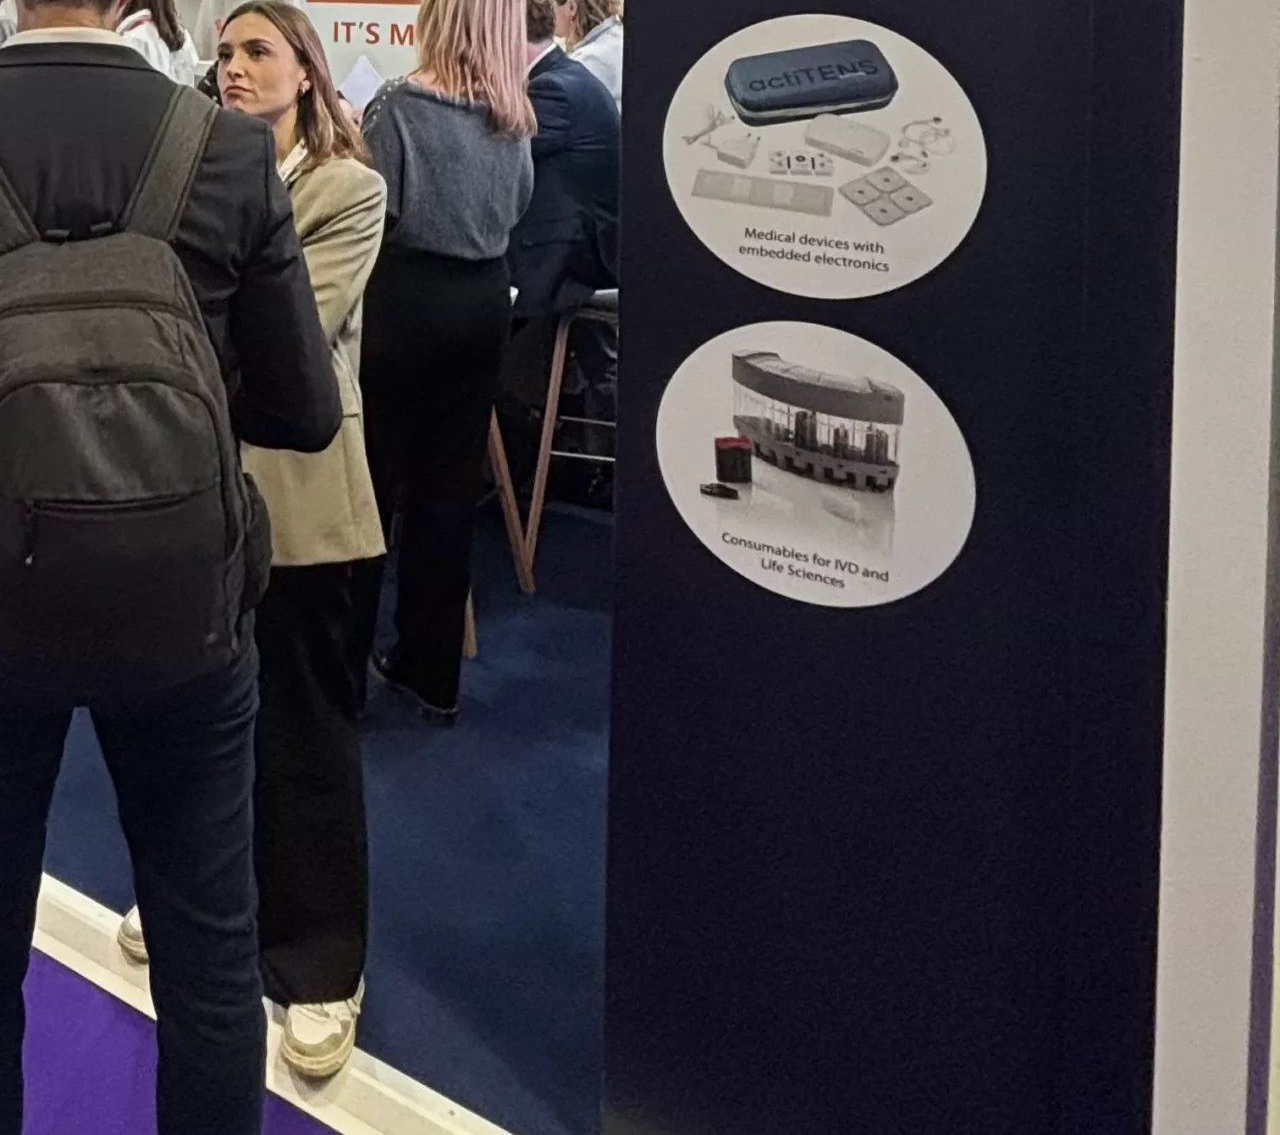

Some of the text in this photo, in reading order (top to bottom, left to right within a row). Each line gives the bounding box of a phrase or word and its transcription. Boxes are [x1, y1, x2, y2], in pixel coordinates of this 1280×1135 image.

[333, 21, 380, 45] IT'S
[748, 59, 879, 92] actiTENS
[744, 227, 885, 255] Medical devices with
[738, 245, 890, 272] embedded electronics
[721, 531, 889, 583] Consumables for IVD and
[760, 557, 845, 589] Life Sciences
